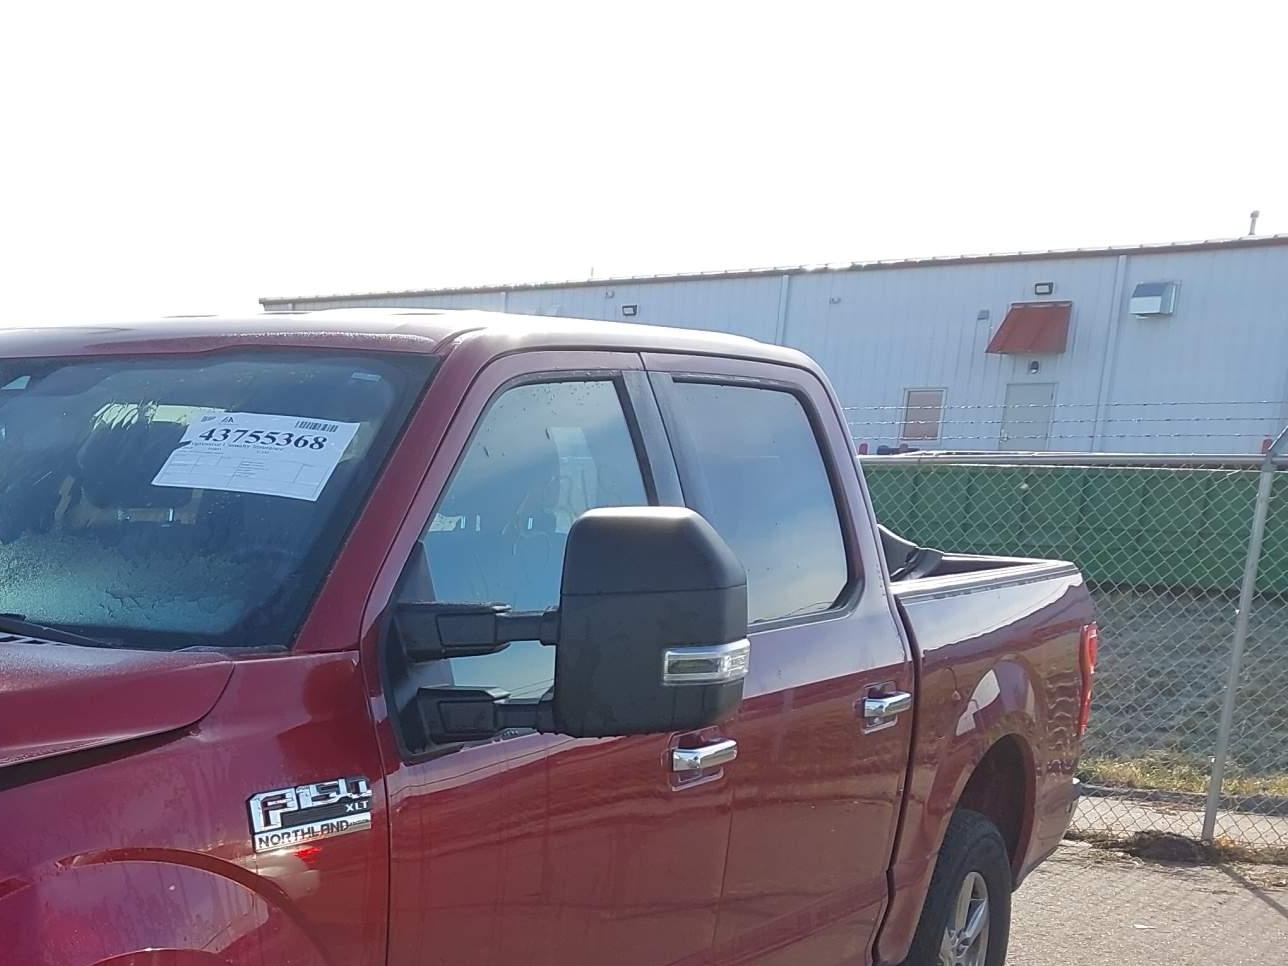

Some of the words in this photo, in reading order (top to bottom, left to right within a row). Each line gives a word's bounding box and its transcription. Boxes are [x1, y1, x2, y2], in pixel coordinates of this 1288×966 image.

[199, 427, 328, 450] 43755368
[345, 800, 369, 812] XLT
[258, 819, 350, 848] NORTHLAND
